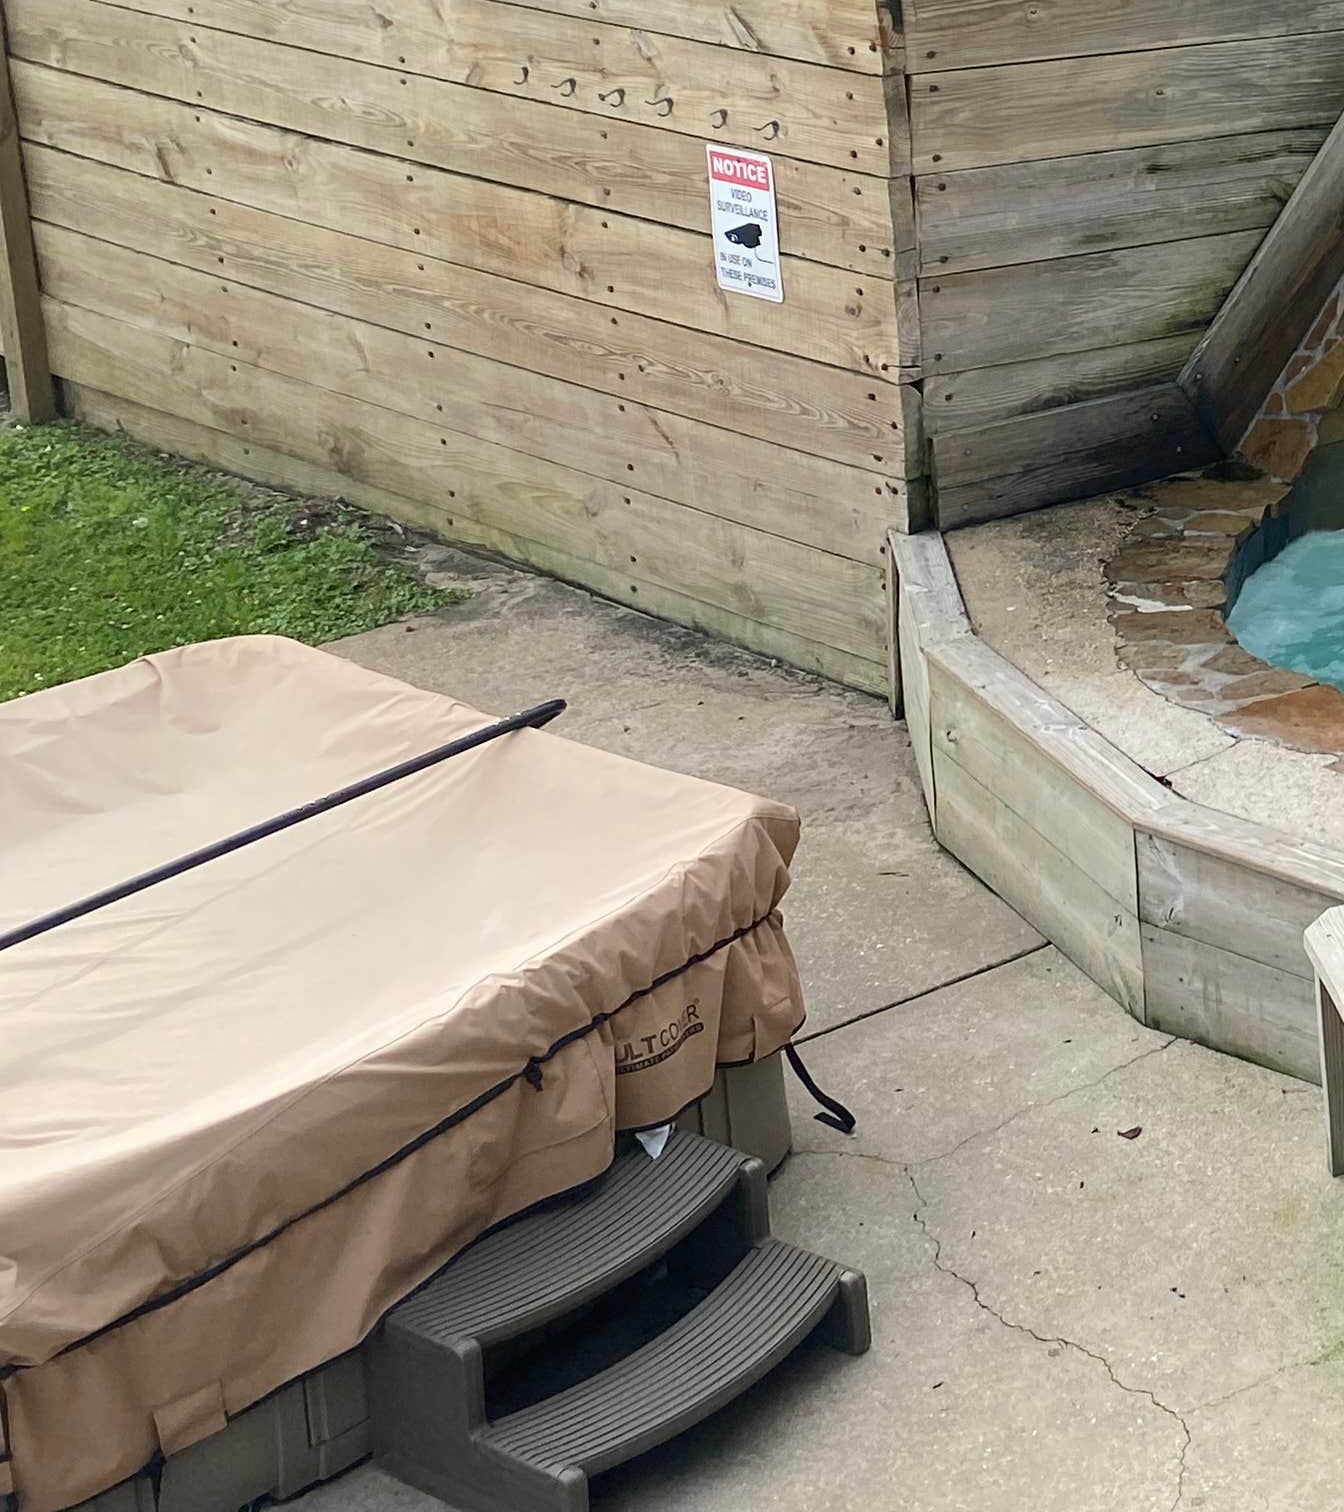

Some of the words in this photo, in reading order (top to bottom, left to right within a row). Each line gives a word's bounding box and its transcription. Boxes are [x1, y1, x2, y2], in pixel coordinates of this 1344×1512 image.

[711, 156, 767, 184] NOTICE
[730, 187, 752, 203] VIDEO
[716, 200, 769, 222] SURVEILLANCE
[728, 253, 740, 265] USE
[742, 256, 752, 268] ON
[720, 267, 742, 281] THESE
[743, 271, 776, 290] PREMISES
